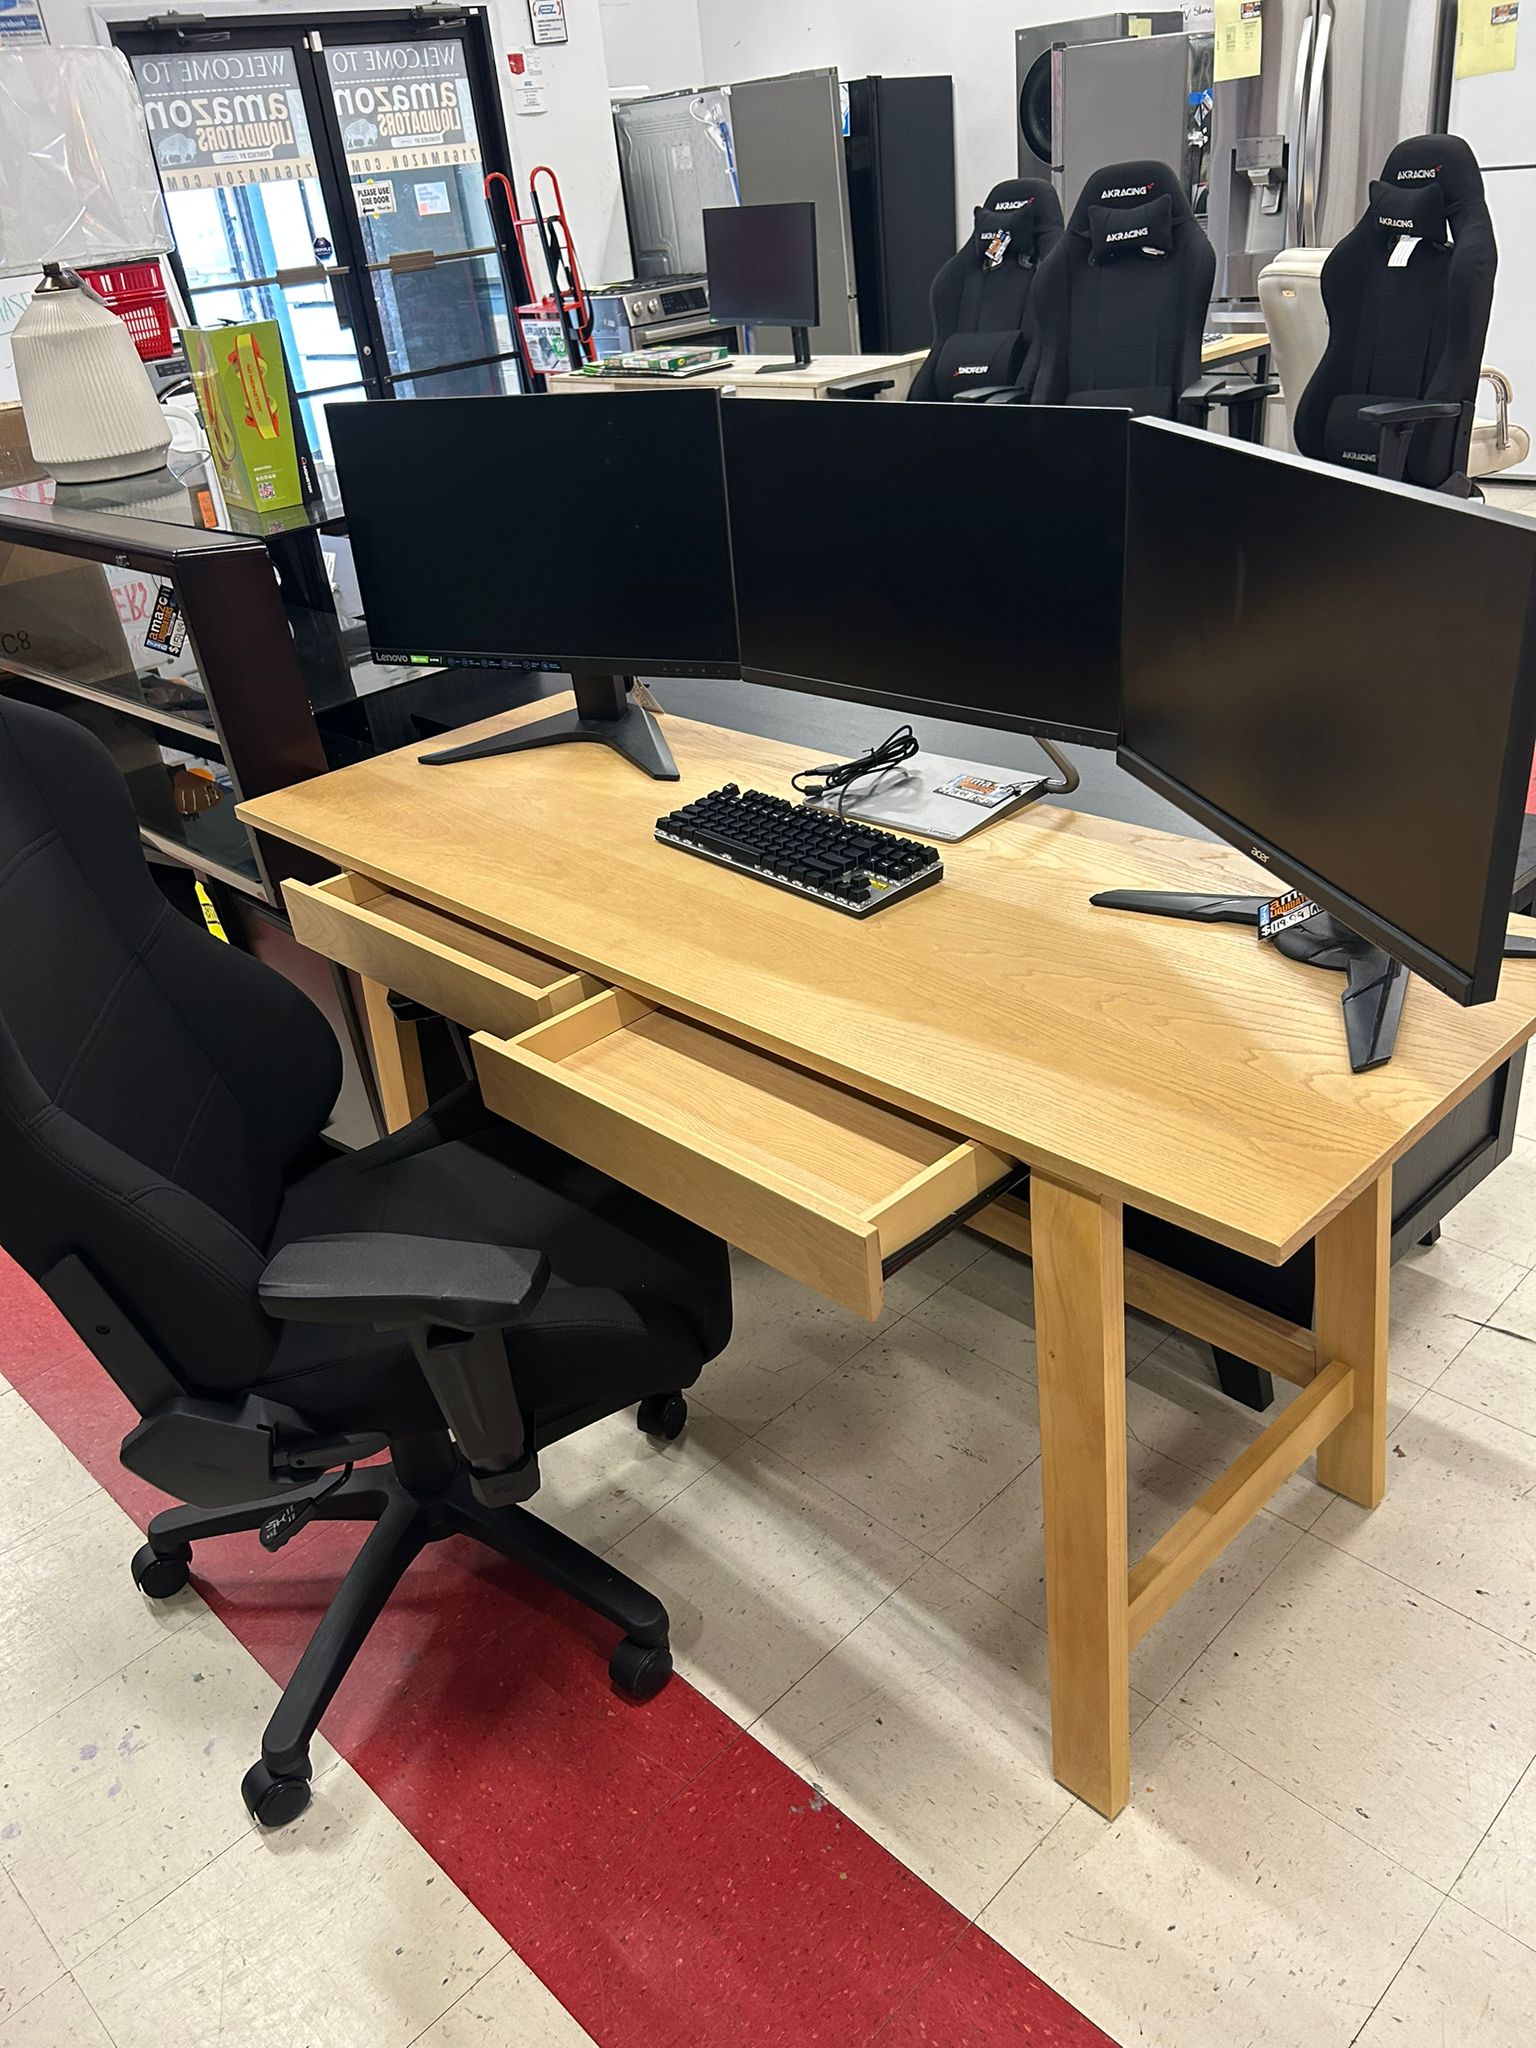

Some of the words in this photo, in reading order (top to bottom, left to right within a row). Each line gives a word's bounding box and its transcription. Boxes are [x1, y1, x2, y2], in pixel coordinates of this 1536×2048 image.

[1396, 168, 1436, 180] AKRACING
[357, 189, 377, 198] PLEASE
[378, 187, 390, 195] USE
[1101, 186, 1147, 199] AKRACING
[361, 198, 373, 206] SIDE
[373, 196, 390, 205] DOOR
[1379, 216, 1414, 228] AKRACING
[1105, 227, 1148, 242] AKRACING
[1342, 451, 1377, 462] AKRACING
[303, 465, 314, 495] MONSTER
[149, 588, 171, 640] amazon
[1, 630, 31, 654] C8
[375, 652, 408, 663] Lenovo
[1250, 846, 1270, 863] acer
